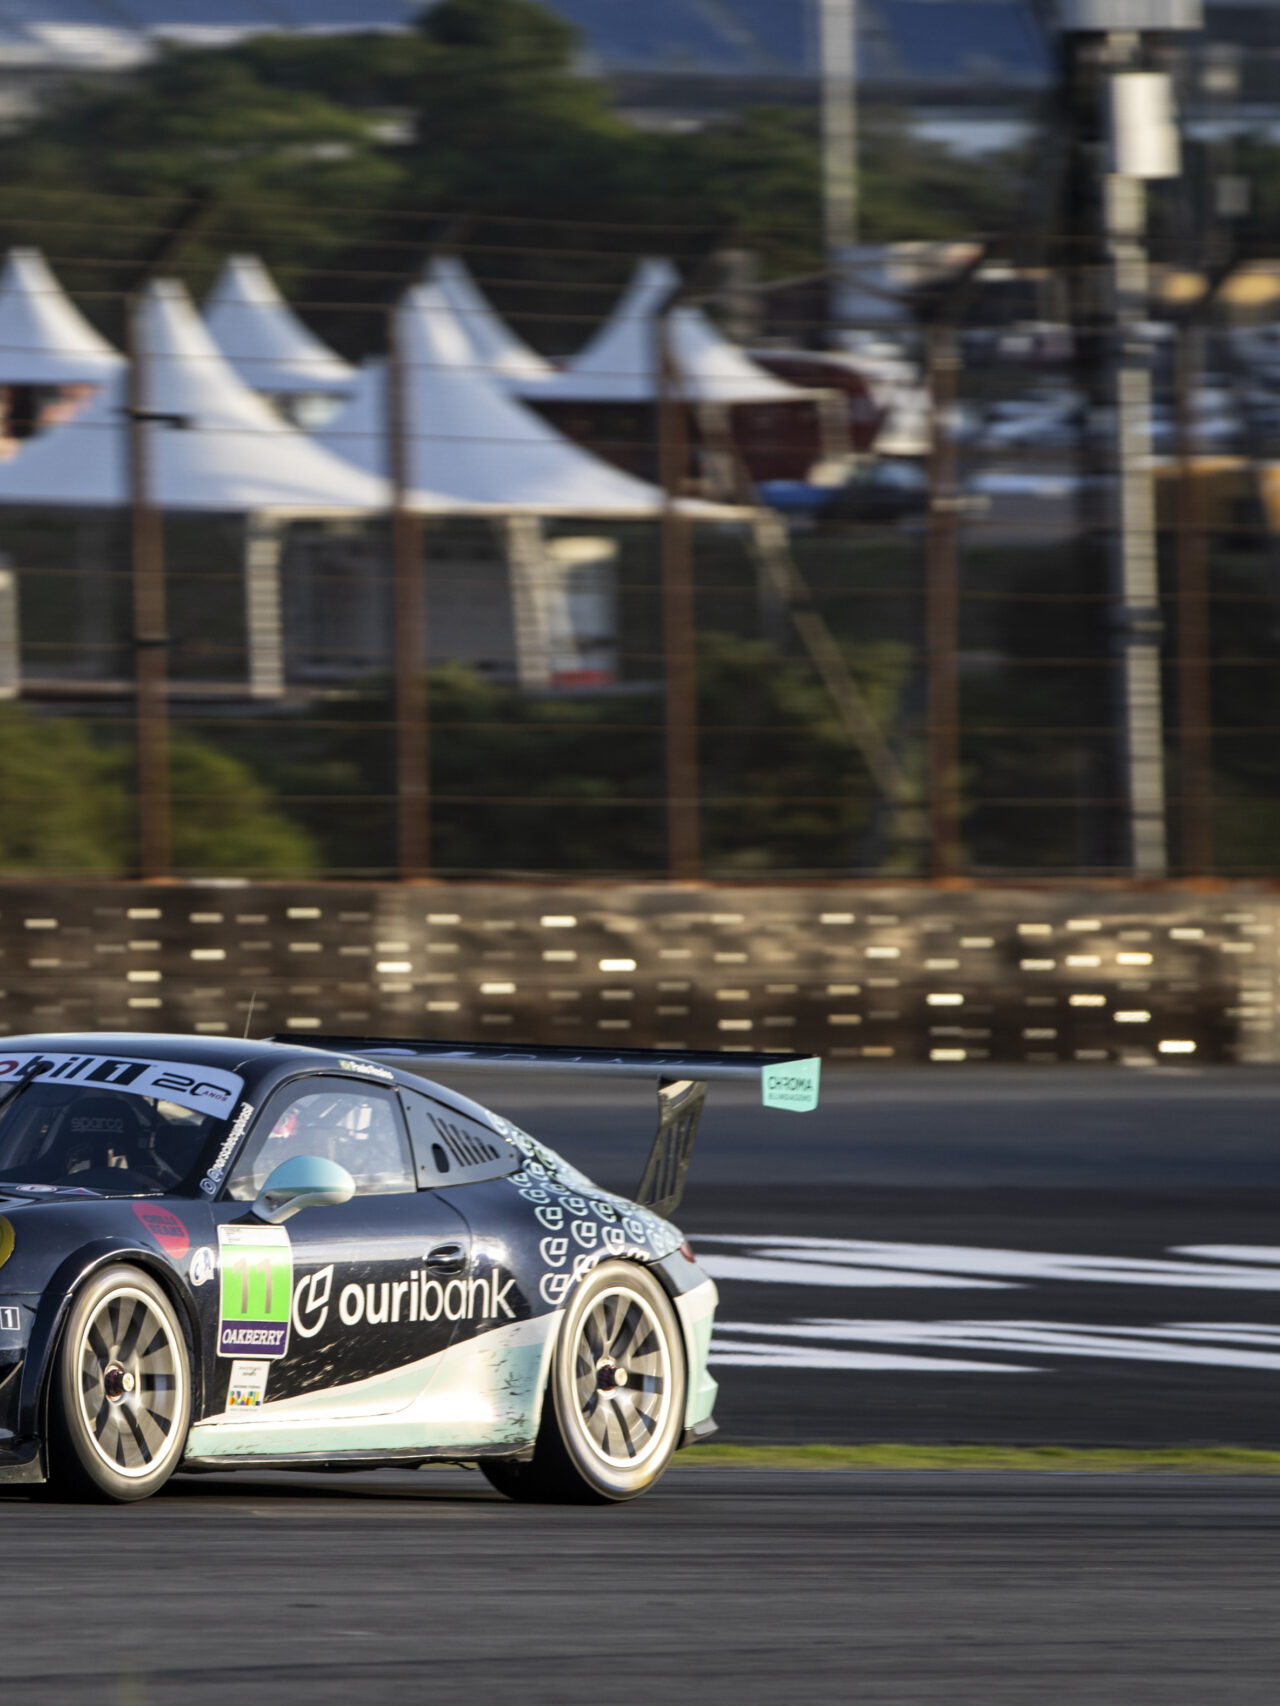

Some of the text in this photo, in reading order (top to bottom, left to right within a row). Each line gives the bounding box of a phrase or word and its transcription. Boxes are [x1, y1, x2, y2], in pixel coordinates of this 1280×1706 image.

[767, 1075, 813, 1092] CHROMA
[71, 1115, 125, 1132] sparco
[232, 1257, 273, 1314] 11
[338, 1267, 517, 1326] ouribank
[221, 1328, 286, 1346] OAKBERRY
